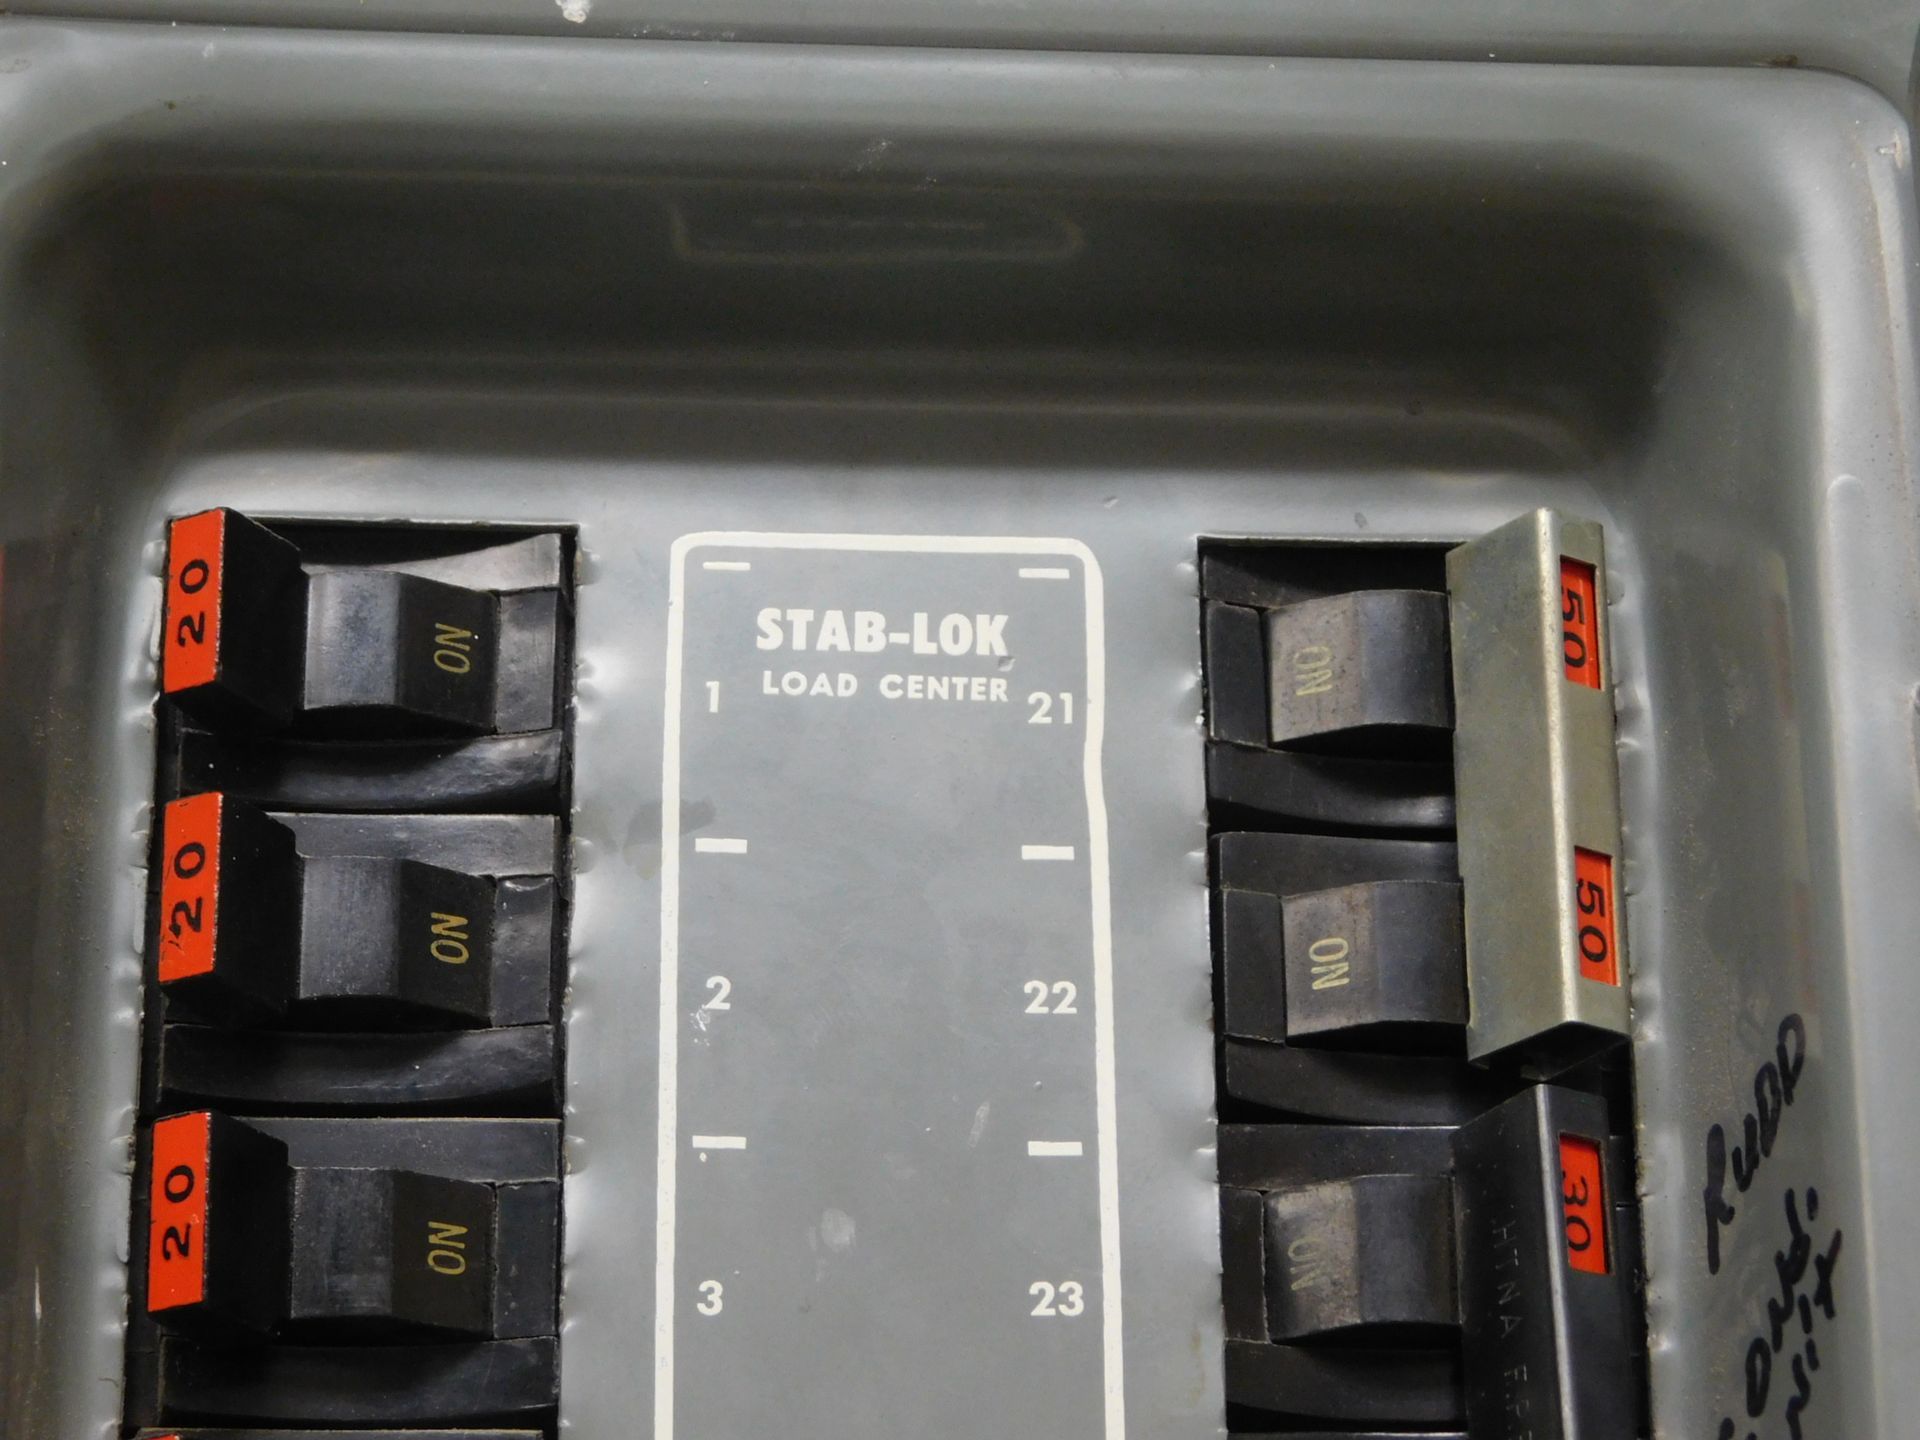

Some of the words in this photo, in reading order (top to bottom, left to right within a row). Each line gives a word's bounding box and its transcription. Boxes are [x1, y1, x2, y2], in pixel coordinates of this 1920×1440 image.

[177, 558, 210, 648] 20
[1561, 587, 1588, 669] 50
[433, 622, 473, 675] ON
[756, 607, 1009, 657] STAB-LOK
[762, 670, 859, 698] LOAD
[879, 673, 1009, 703] CENTER
[1294, 644, 1333, 696] ON
[705, 681, 721, 713] 1
[1027, 691, 1074, 724] 21
[170, 841, 206, 936] 20
[430, 911, 470, 965] ON
[1576, 878, 1608, 965] 50
[1307, 936, 1351, 992] ON
[701, 975, 732, 1010] 2
[1023, 980, 1078, 1015] 22
[161, 1164, 195, 1262] 20
[1562, 1170, 1592, 1252] 30
[427, 1220, 469, 1275] ON
[1287, 1236, 1330, 1291] ON
[696, 1279, 724, 1316] 3
[1028, 1280, 1085, 1317] 23
